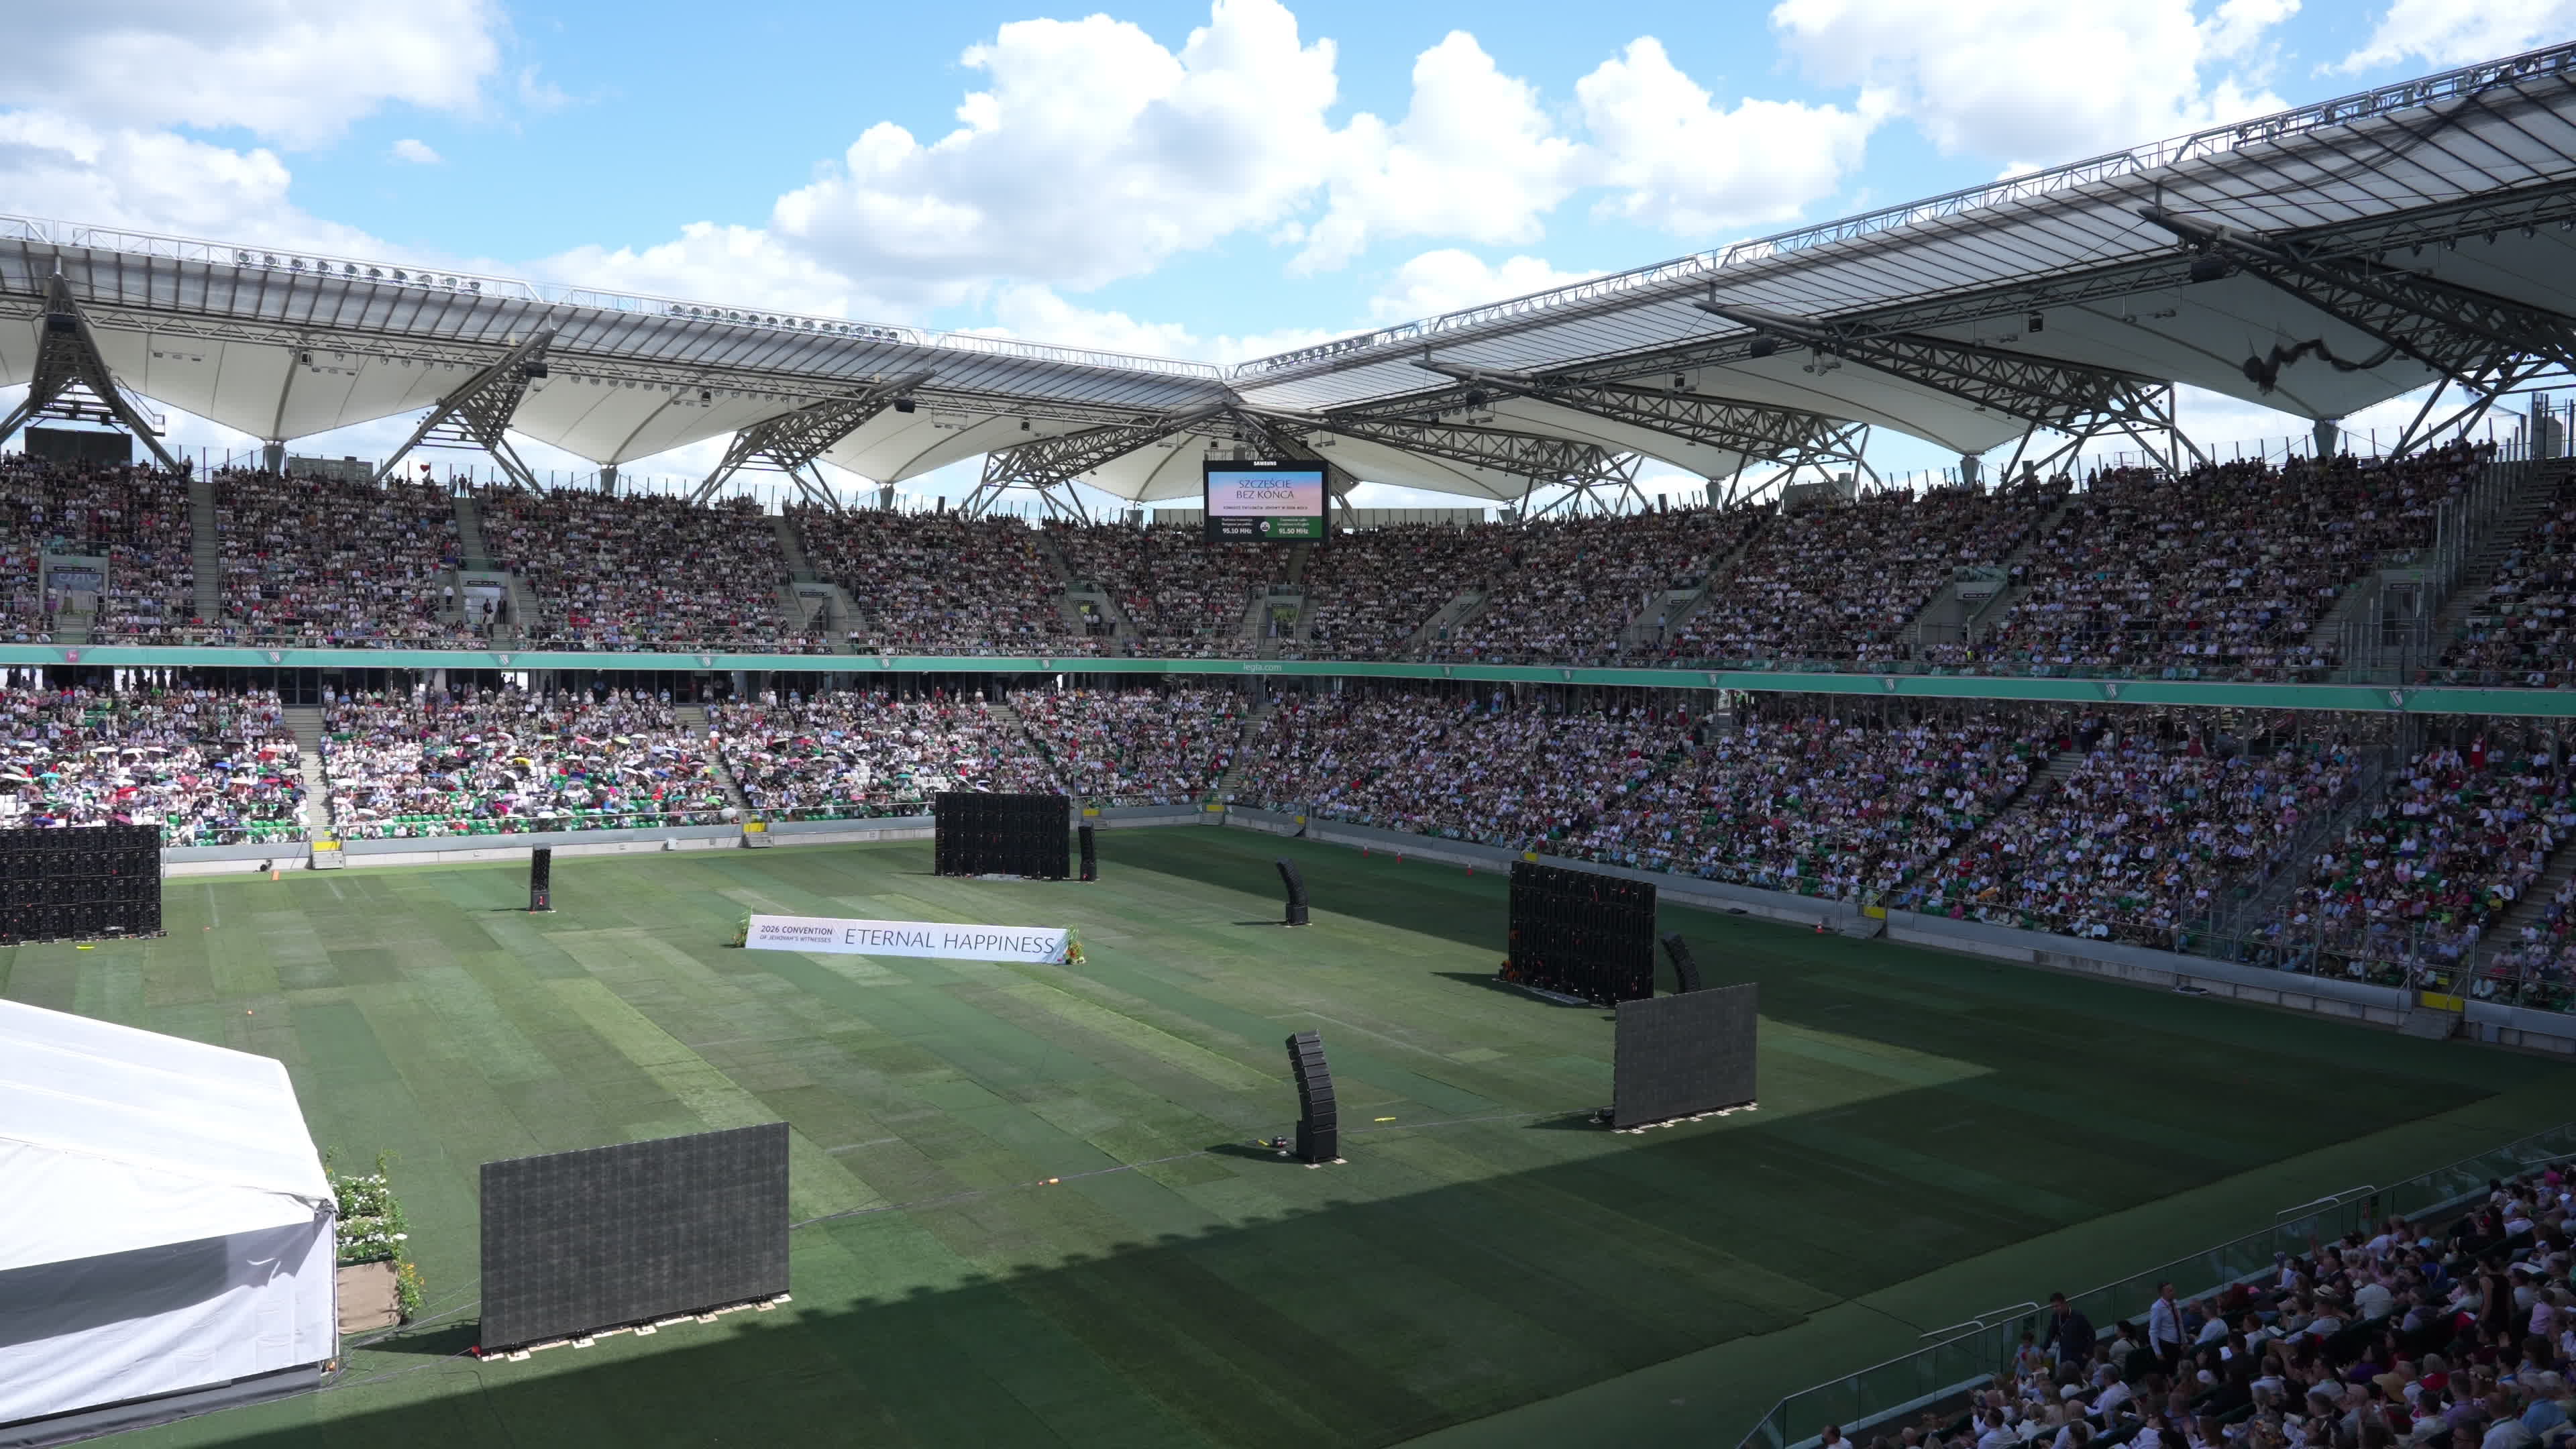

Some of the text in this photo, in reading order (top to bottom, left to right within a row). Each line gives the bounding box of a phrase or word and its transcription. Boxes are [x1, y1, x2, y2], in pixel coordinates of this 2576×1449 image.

[1236, 490, 1254, 499] BEZ
[1244, 662, 1282, 673] legia.com
[761, 925, 833, 935] 2026 CONVENTION
[845, 928, 1055, 953] ETERNAL HAPPINESS
